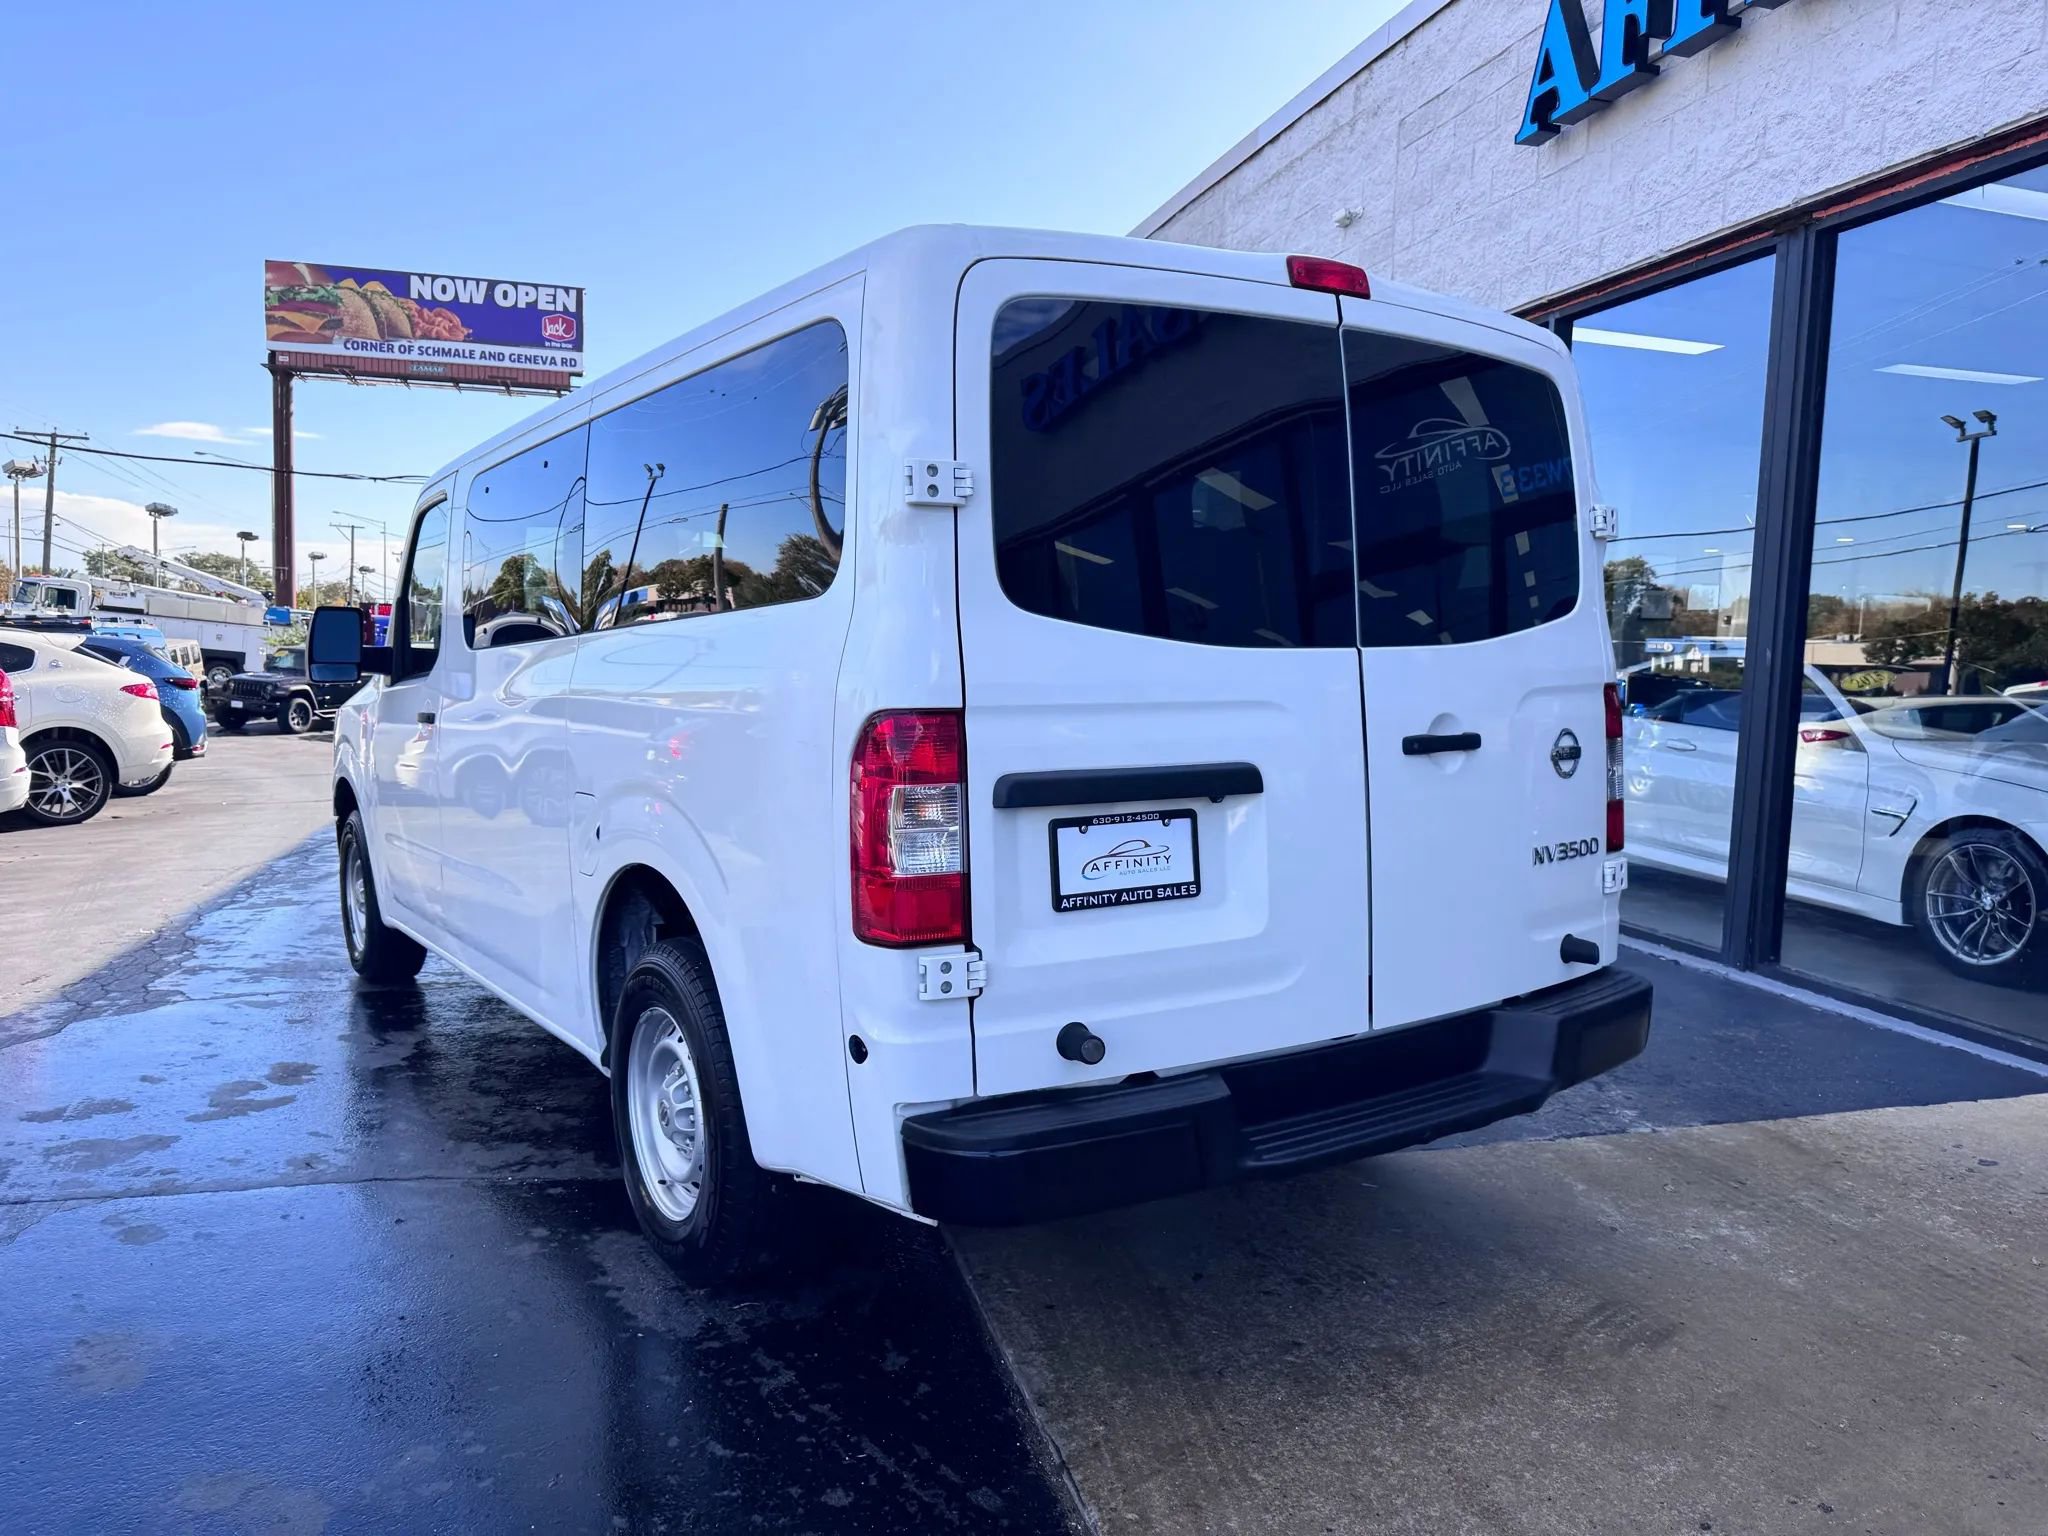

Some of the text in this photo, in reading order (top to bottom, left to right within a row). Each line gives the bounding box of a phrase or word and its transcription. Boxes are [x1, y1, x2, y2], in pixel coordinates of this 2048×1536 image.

[410, 275, 577, 313] NOW OPEN
[544, 317, 574, 338] Jack
[343, 339, 578, 368] CORNER OF SCHMALE AND GENEVA RD
[1090, 854, 1172, 873] AFFINITY
[1533, 837, 1599, 866] NV3500
[1060, 884, 1197, 909] AFFINITY AUTO SALES
